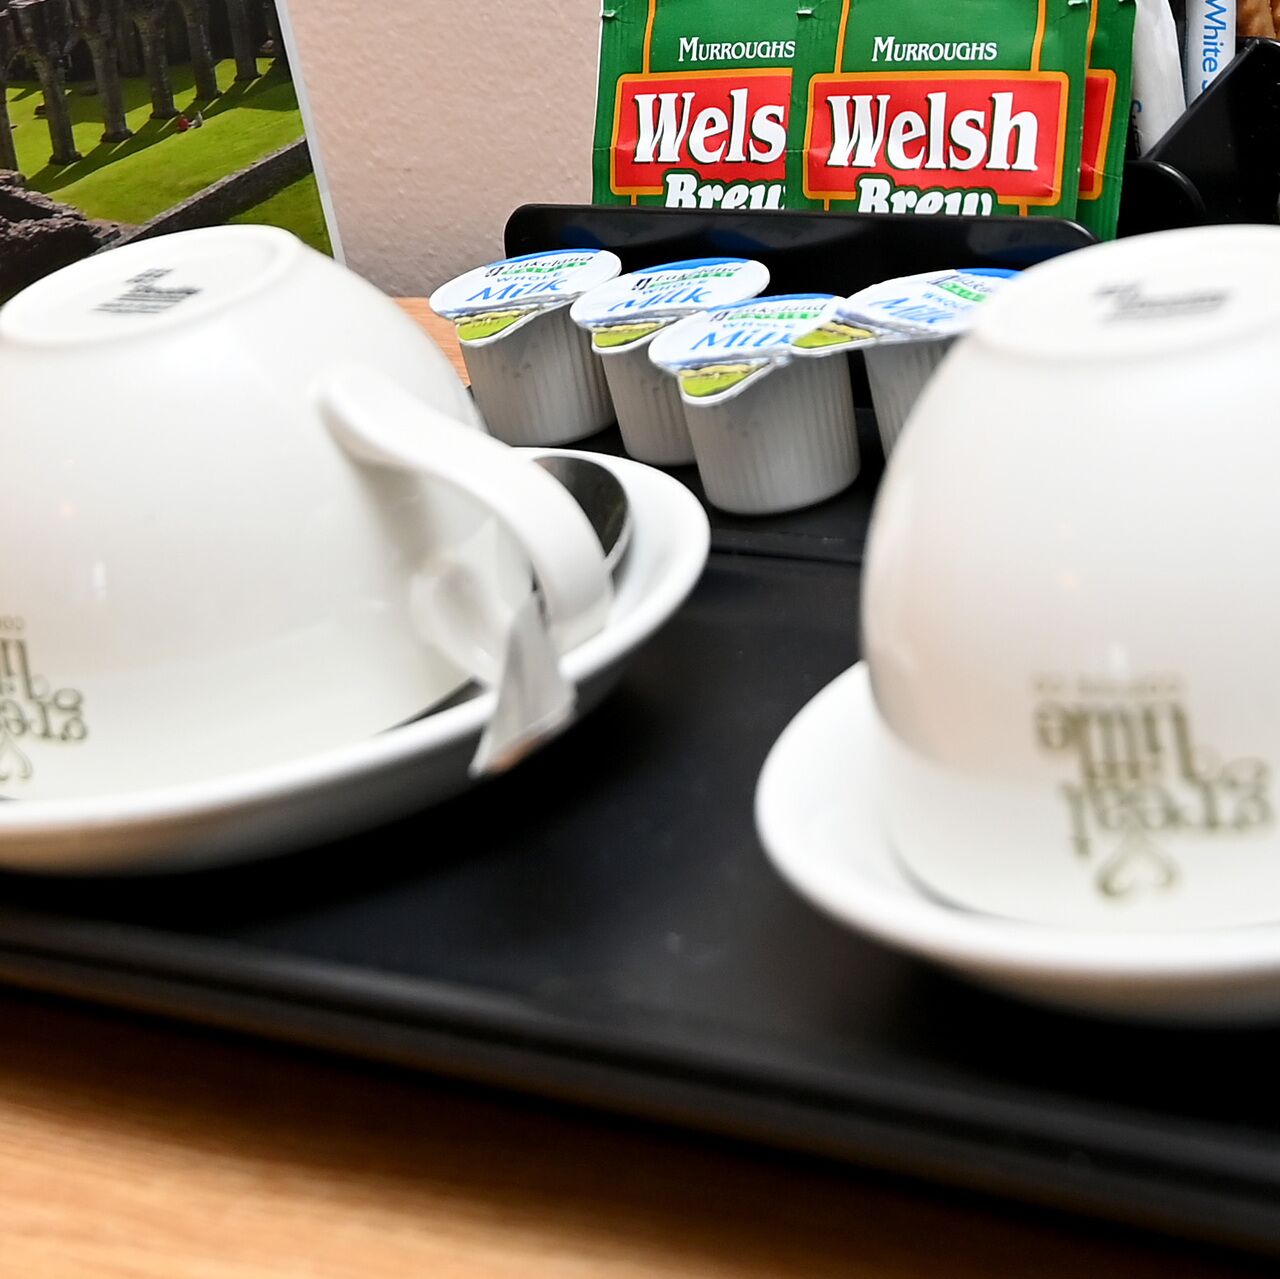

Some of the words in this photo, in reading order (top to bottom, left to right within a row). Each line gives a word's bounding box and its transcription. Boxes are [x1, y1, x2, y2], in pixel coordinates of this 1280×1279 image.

[678, 36, 796, 62] MURROUGHS
[872, 35, 998, 62] MURROUGHS
[633, 88, 787, 164] Wels
[825, 91, 1038, 172] Welsh
[858, 177, 993, 217] Brew
[466, 278, 569, 302] Milk
[607, 287, 712, 312] Milk
[690, 328, 794, 350] Milk
